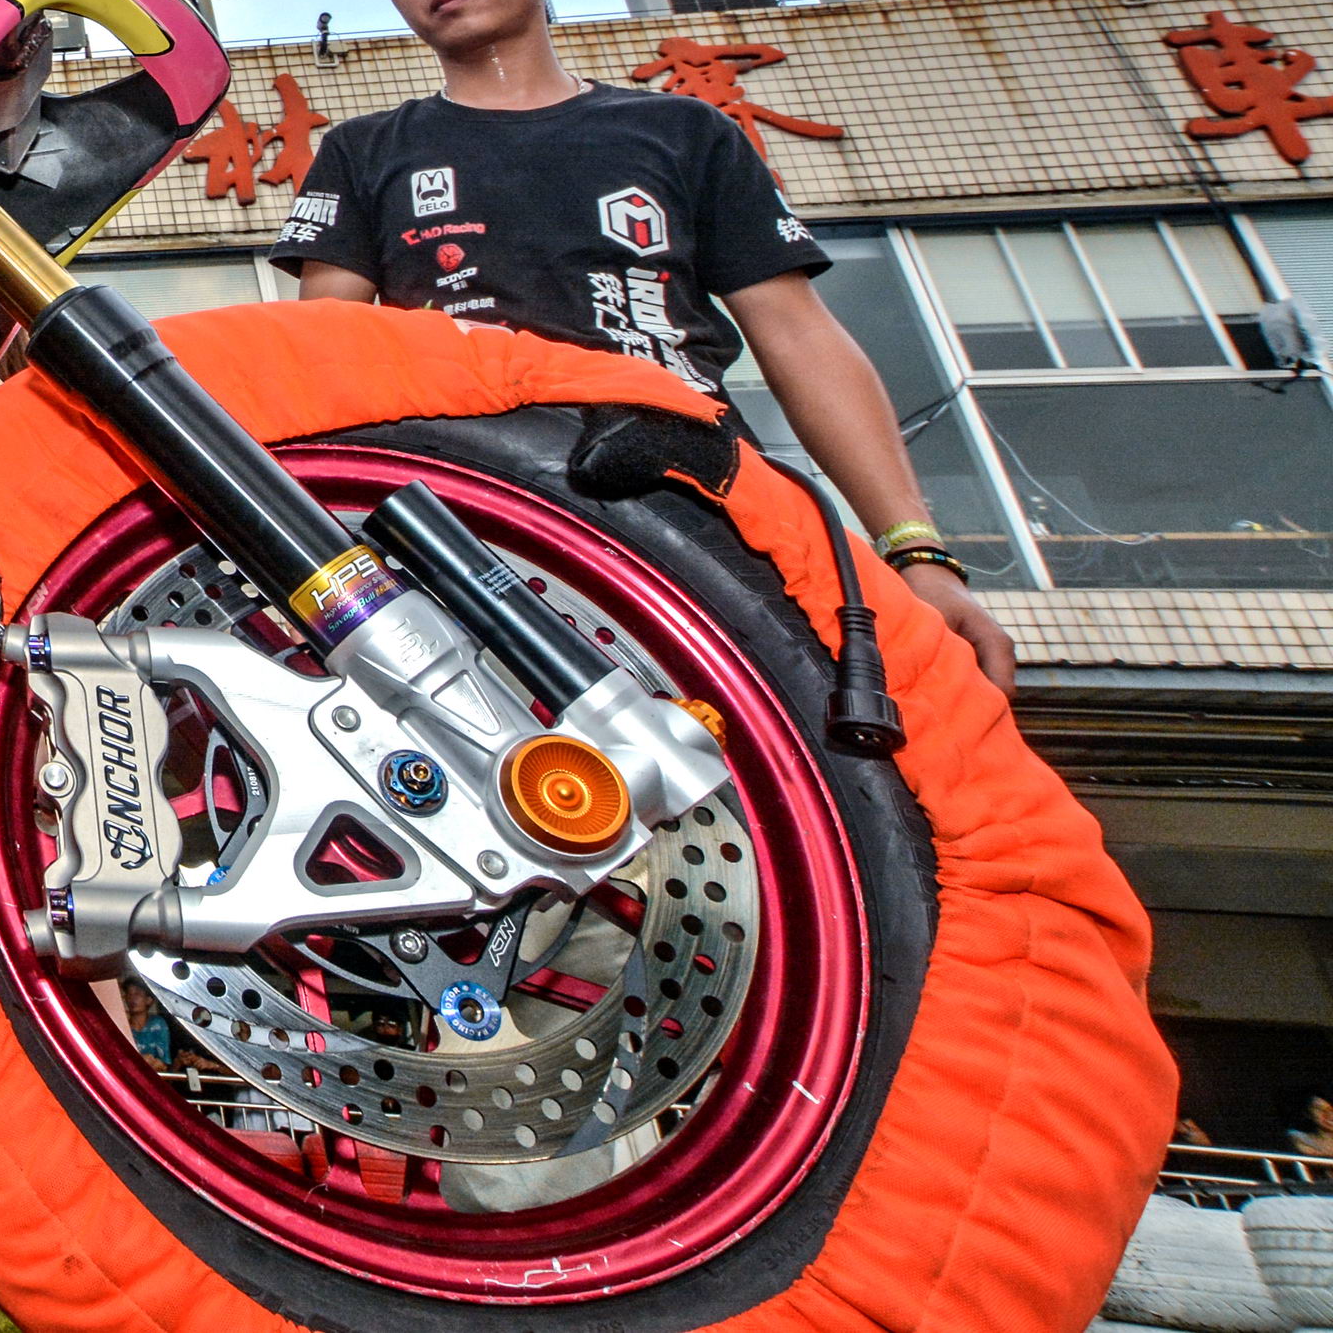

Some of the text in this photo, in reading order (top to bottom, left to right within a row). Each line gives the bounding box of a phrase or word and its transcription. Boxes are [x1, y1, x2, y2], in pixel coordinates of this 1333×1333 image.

[310, 553, 380, 611] HPS
[96, 685, 154, 870] ANCHOR
[248, 766, 261, 797] 210817
